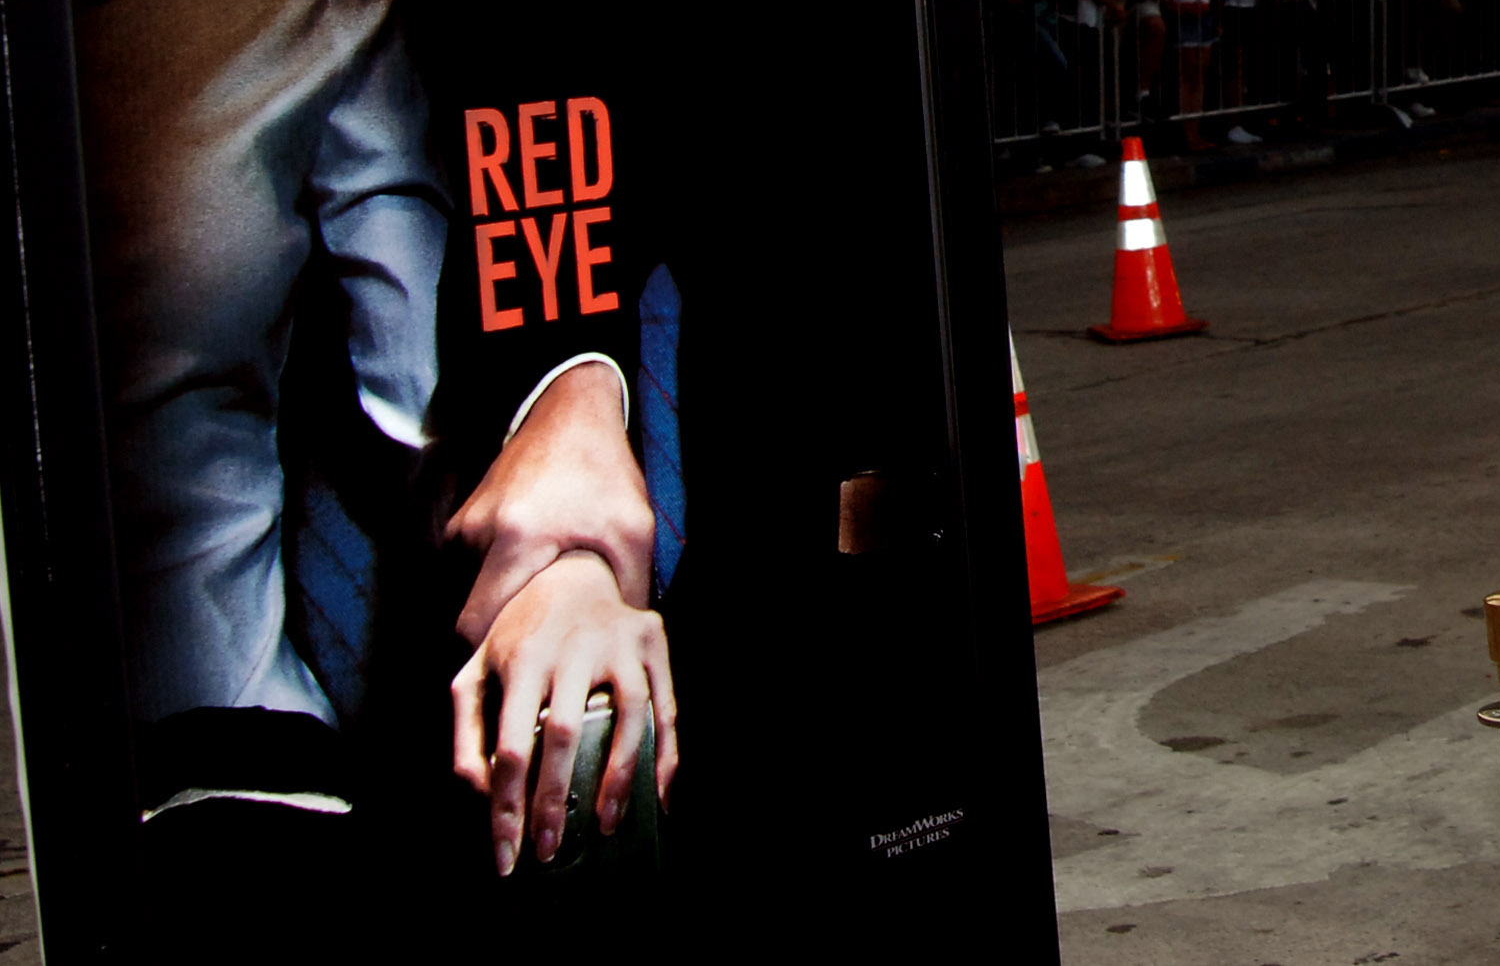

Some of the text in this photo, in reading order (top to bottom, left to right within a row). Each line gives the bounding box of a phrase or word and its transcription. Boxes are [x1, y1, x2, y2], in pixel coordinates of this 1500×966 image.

[464, 96, 614, 217] RED
[475, 206, 620, 332] EYE
[886, 827, 951, 858] PICTURES
